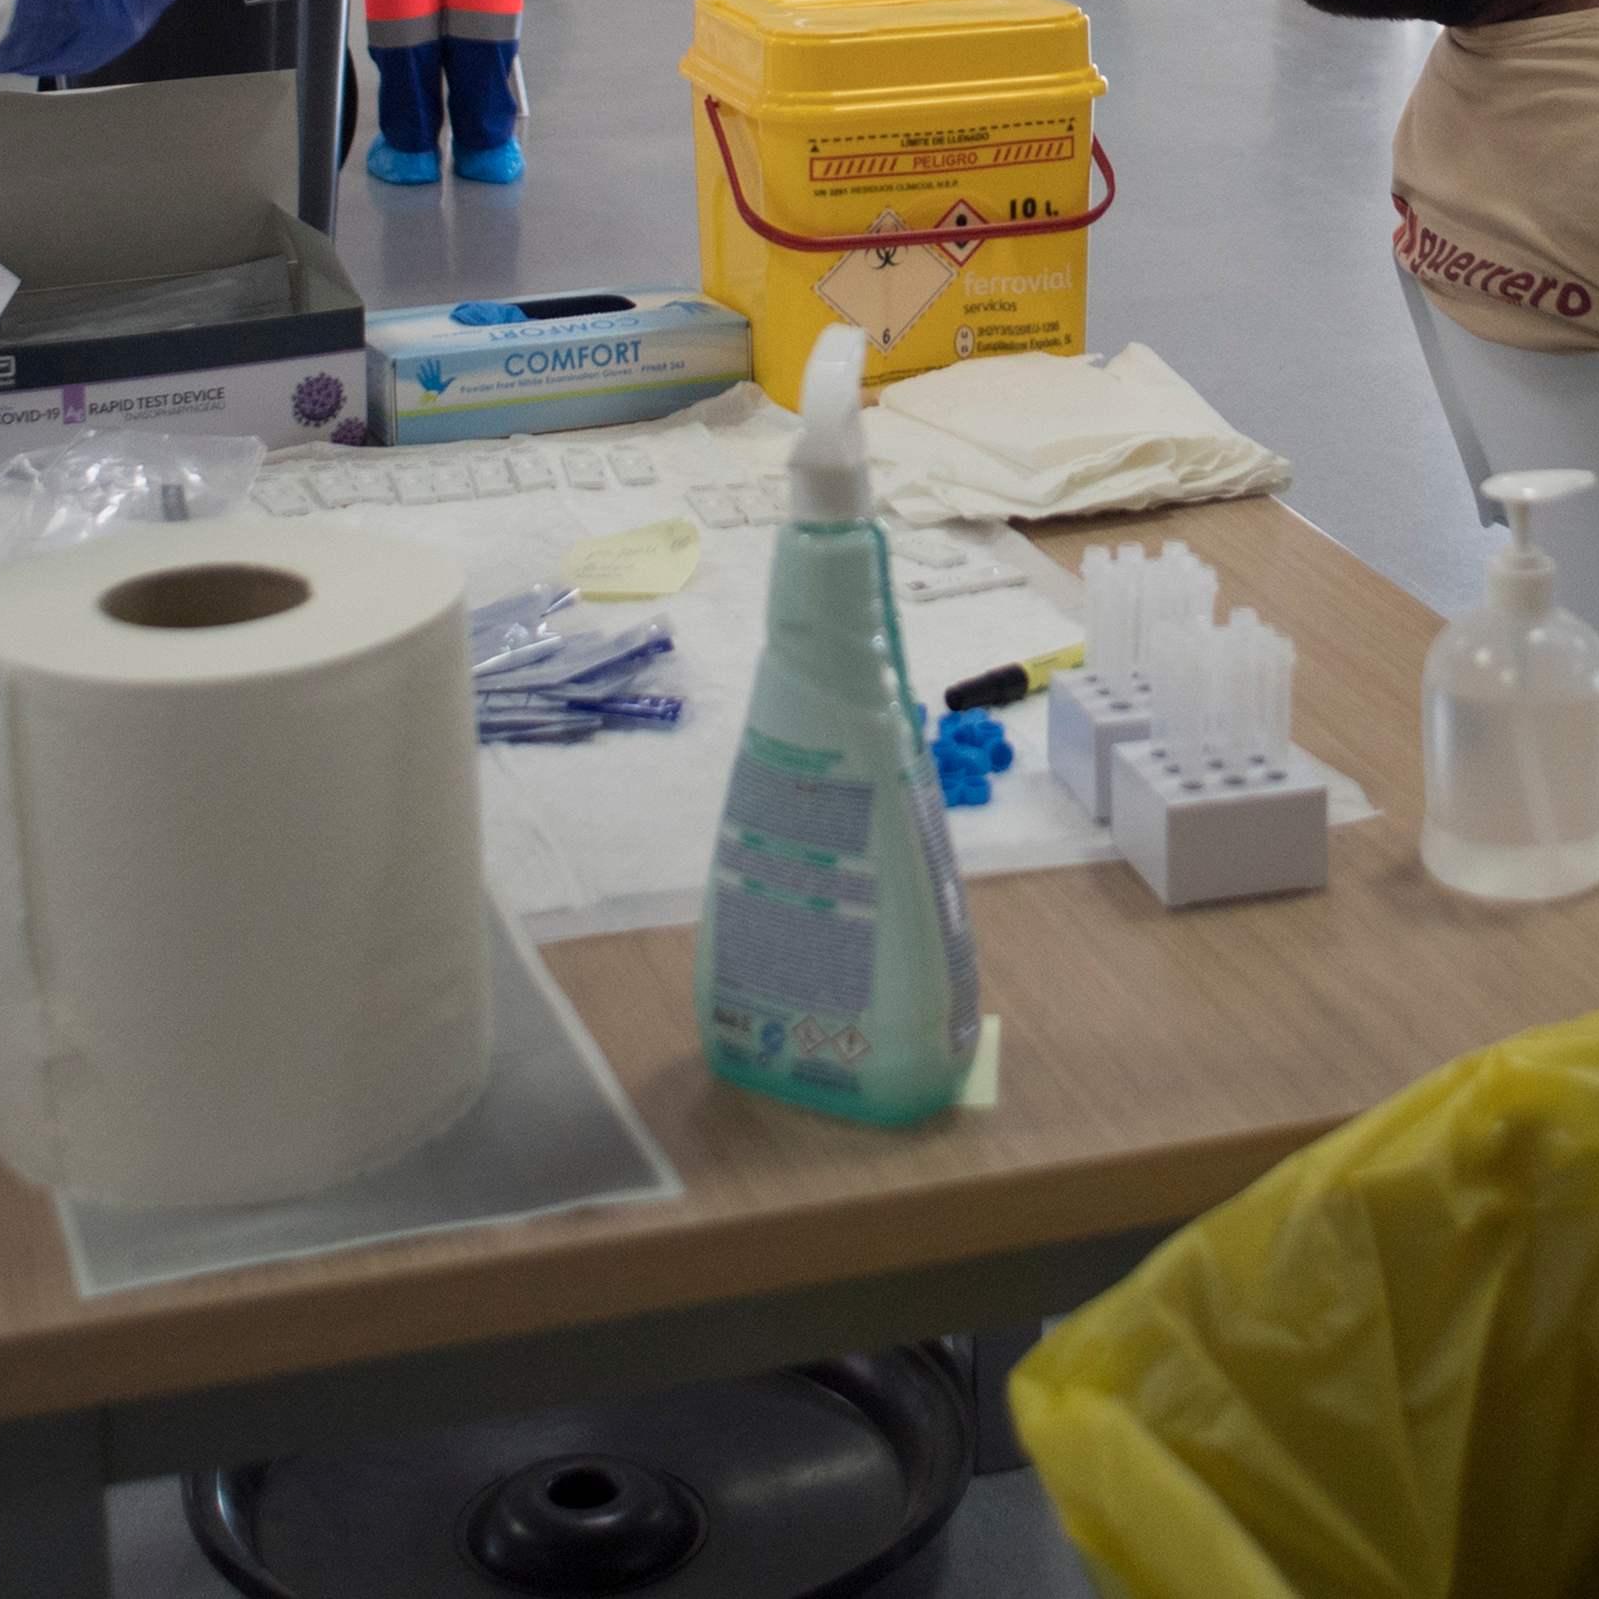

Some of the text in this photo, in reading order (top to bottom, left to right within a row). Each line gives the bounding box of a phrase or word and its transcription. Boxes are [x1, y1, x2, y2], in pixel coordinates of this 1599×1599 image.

[913, 151, 978, 169] PELIGRO
[1010, 197, 1037, 221] 10
[963, 262, 1073, 298] ferrovial
[1410, 227, 1592, 318] guerrero
[963, 299, 1017, 315] servicios
[882, 327, 891, 345] 6
[504, 338, 642, 377] COMFORT
[88, 398, 134, 416] RAPID
[136, 393, 170, 410] TEST
[171, 386, 225, 406] DEVICE
